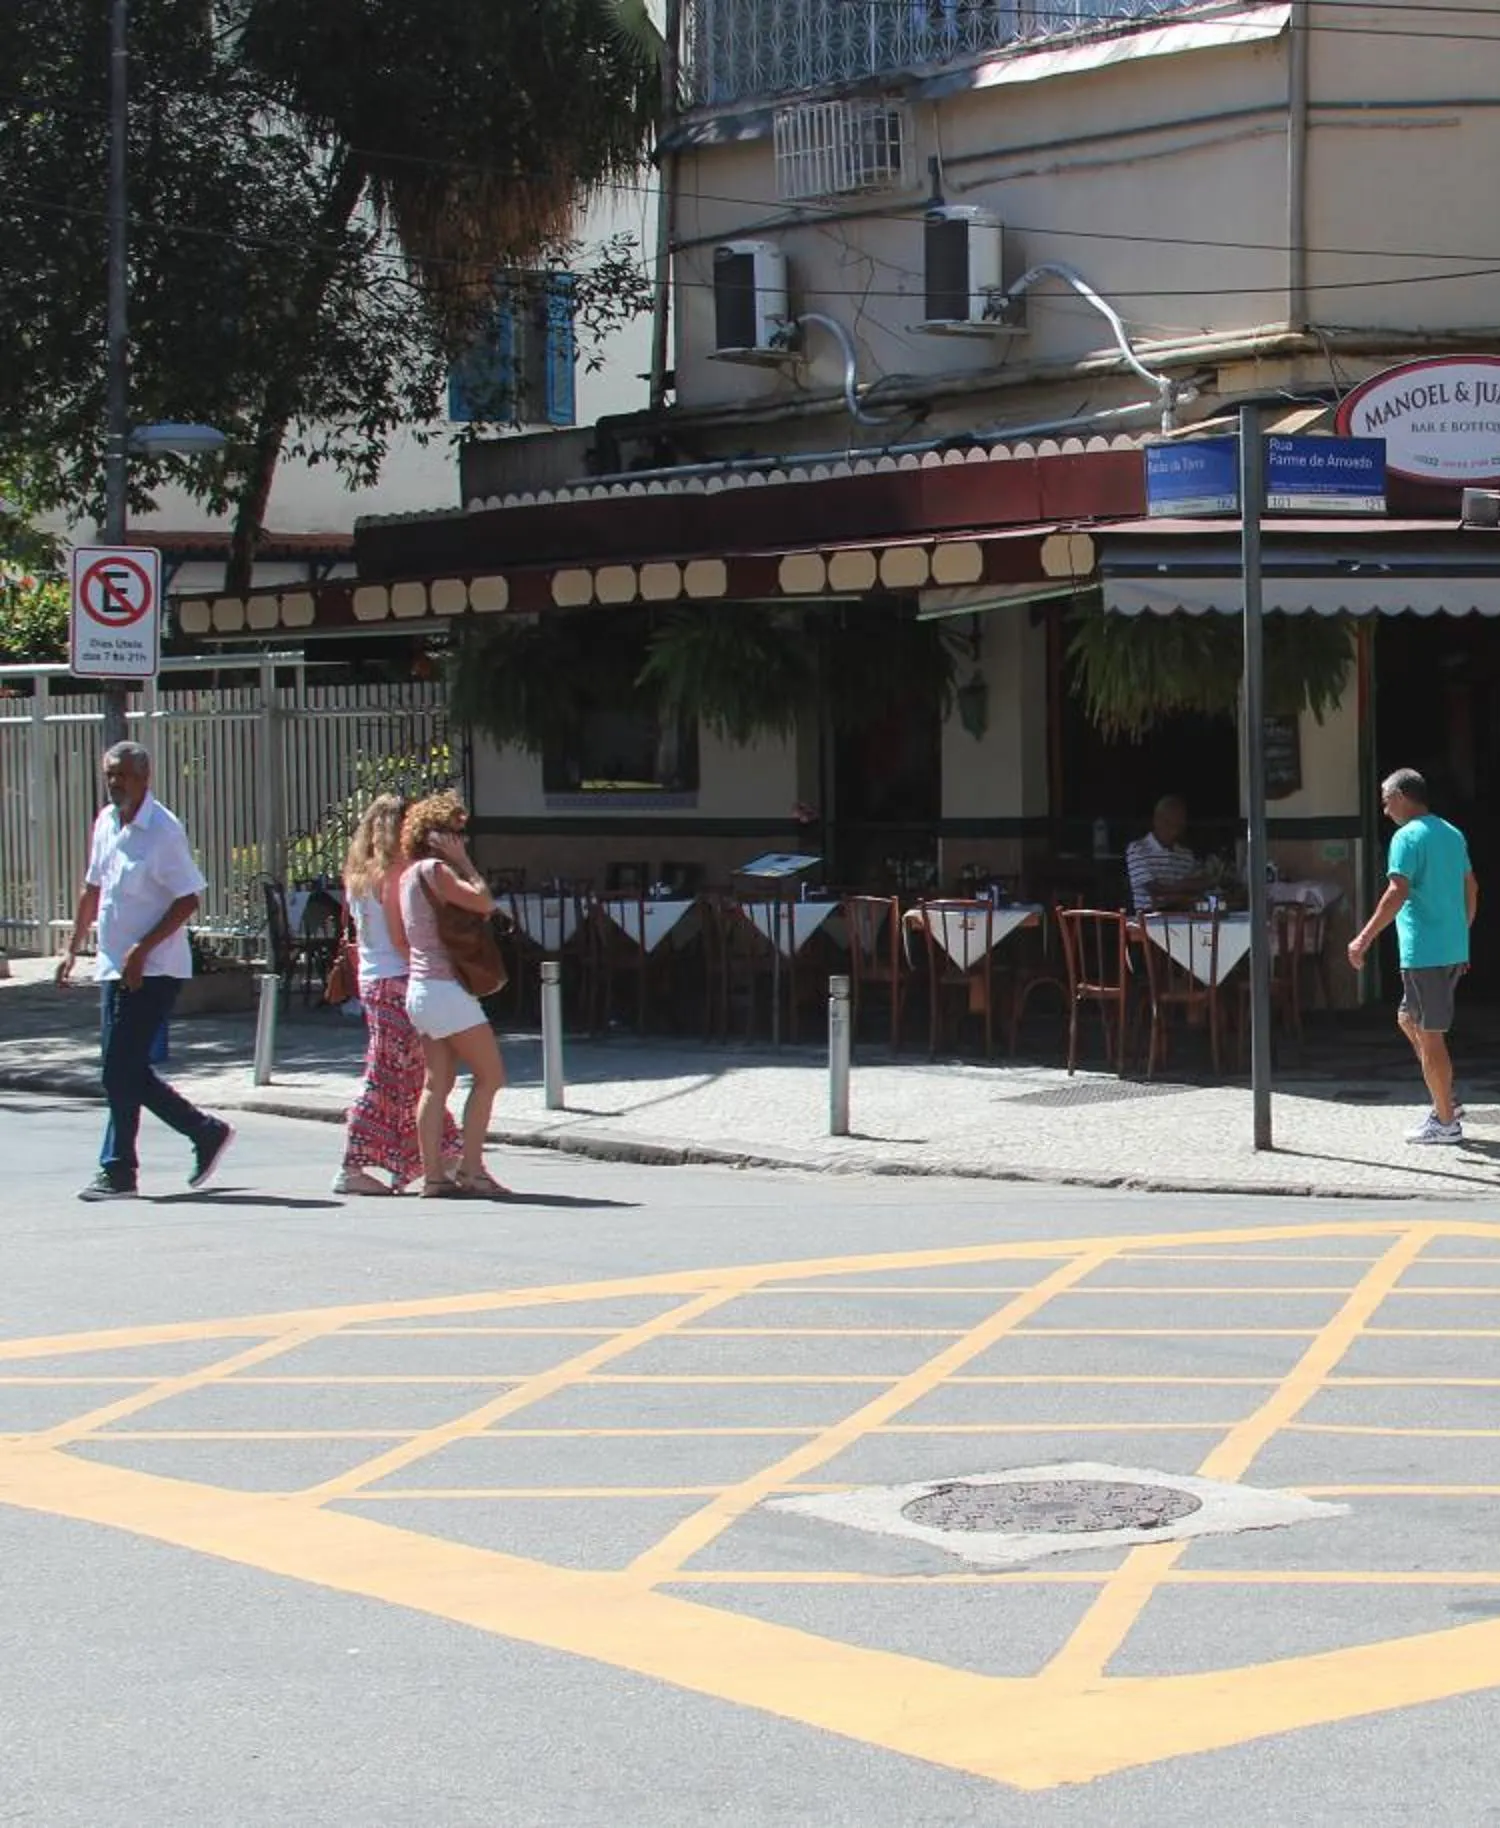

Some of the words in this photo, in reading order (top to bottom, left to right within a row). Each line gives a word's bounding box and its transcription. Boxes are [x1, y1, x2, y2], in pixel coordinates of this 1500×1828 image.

[1364, 384, 1450, 433] MANOEL
[1454, 381, 1470, 403] &
[1411, 421, 1436, 433] BAR
[1440, 421, 1450, 432] E
[1269, 437, 1293, 452] Rua
[1269, 452, 1307, 466] Farme
[1309, 453, 1325, 467] de
[89, 638, 113, 649] Dias
[103, 652, 110, 662] 7
